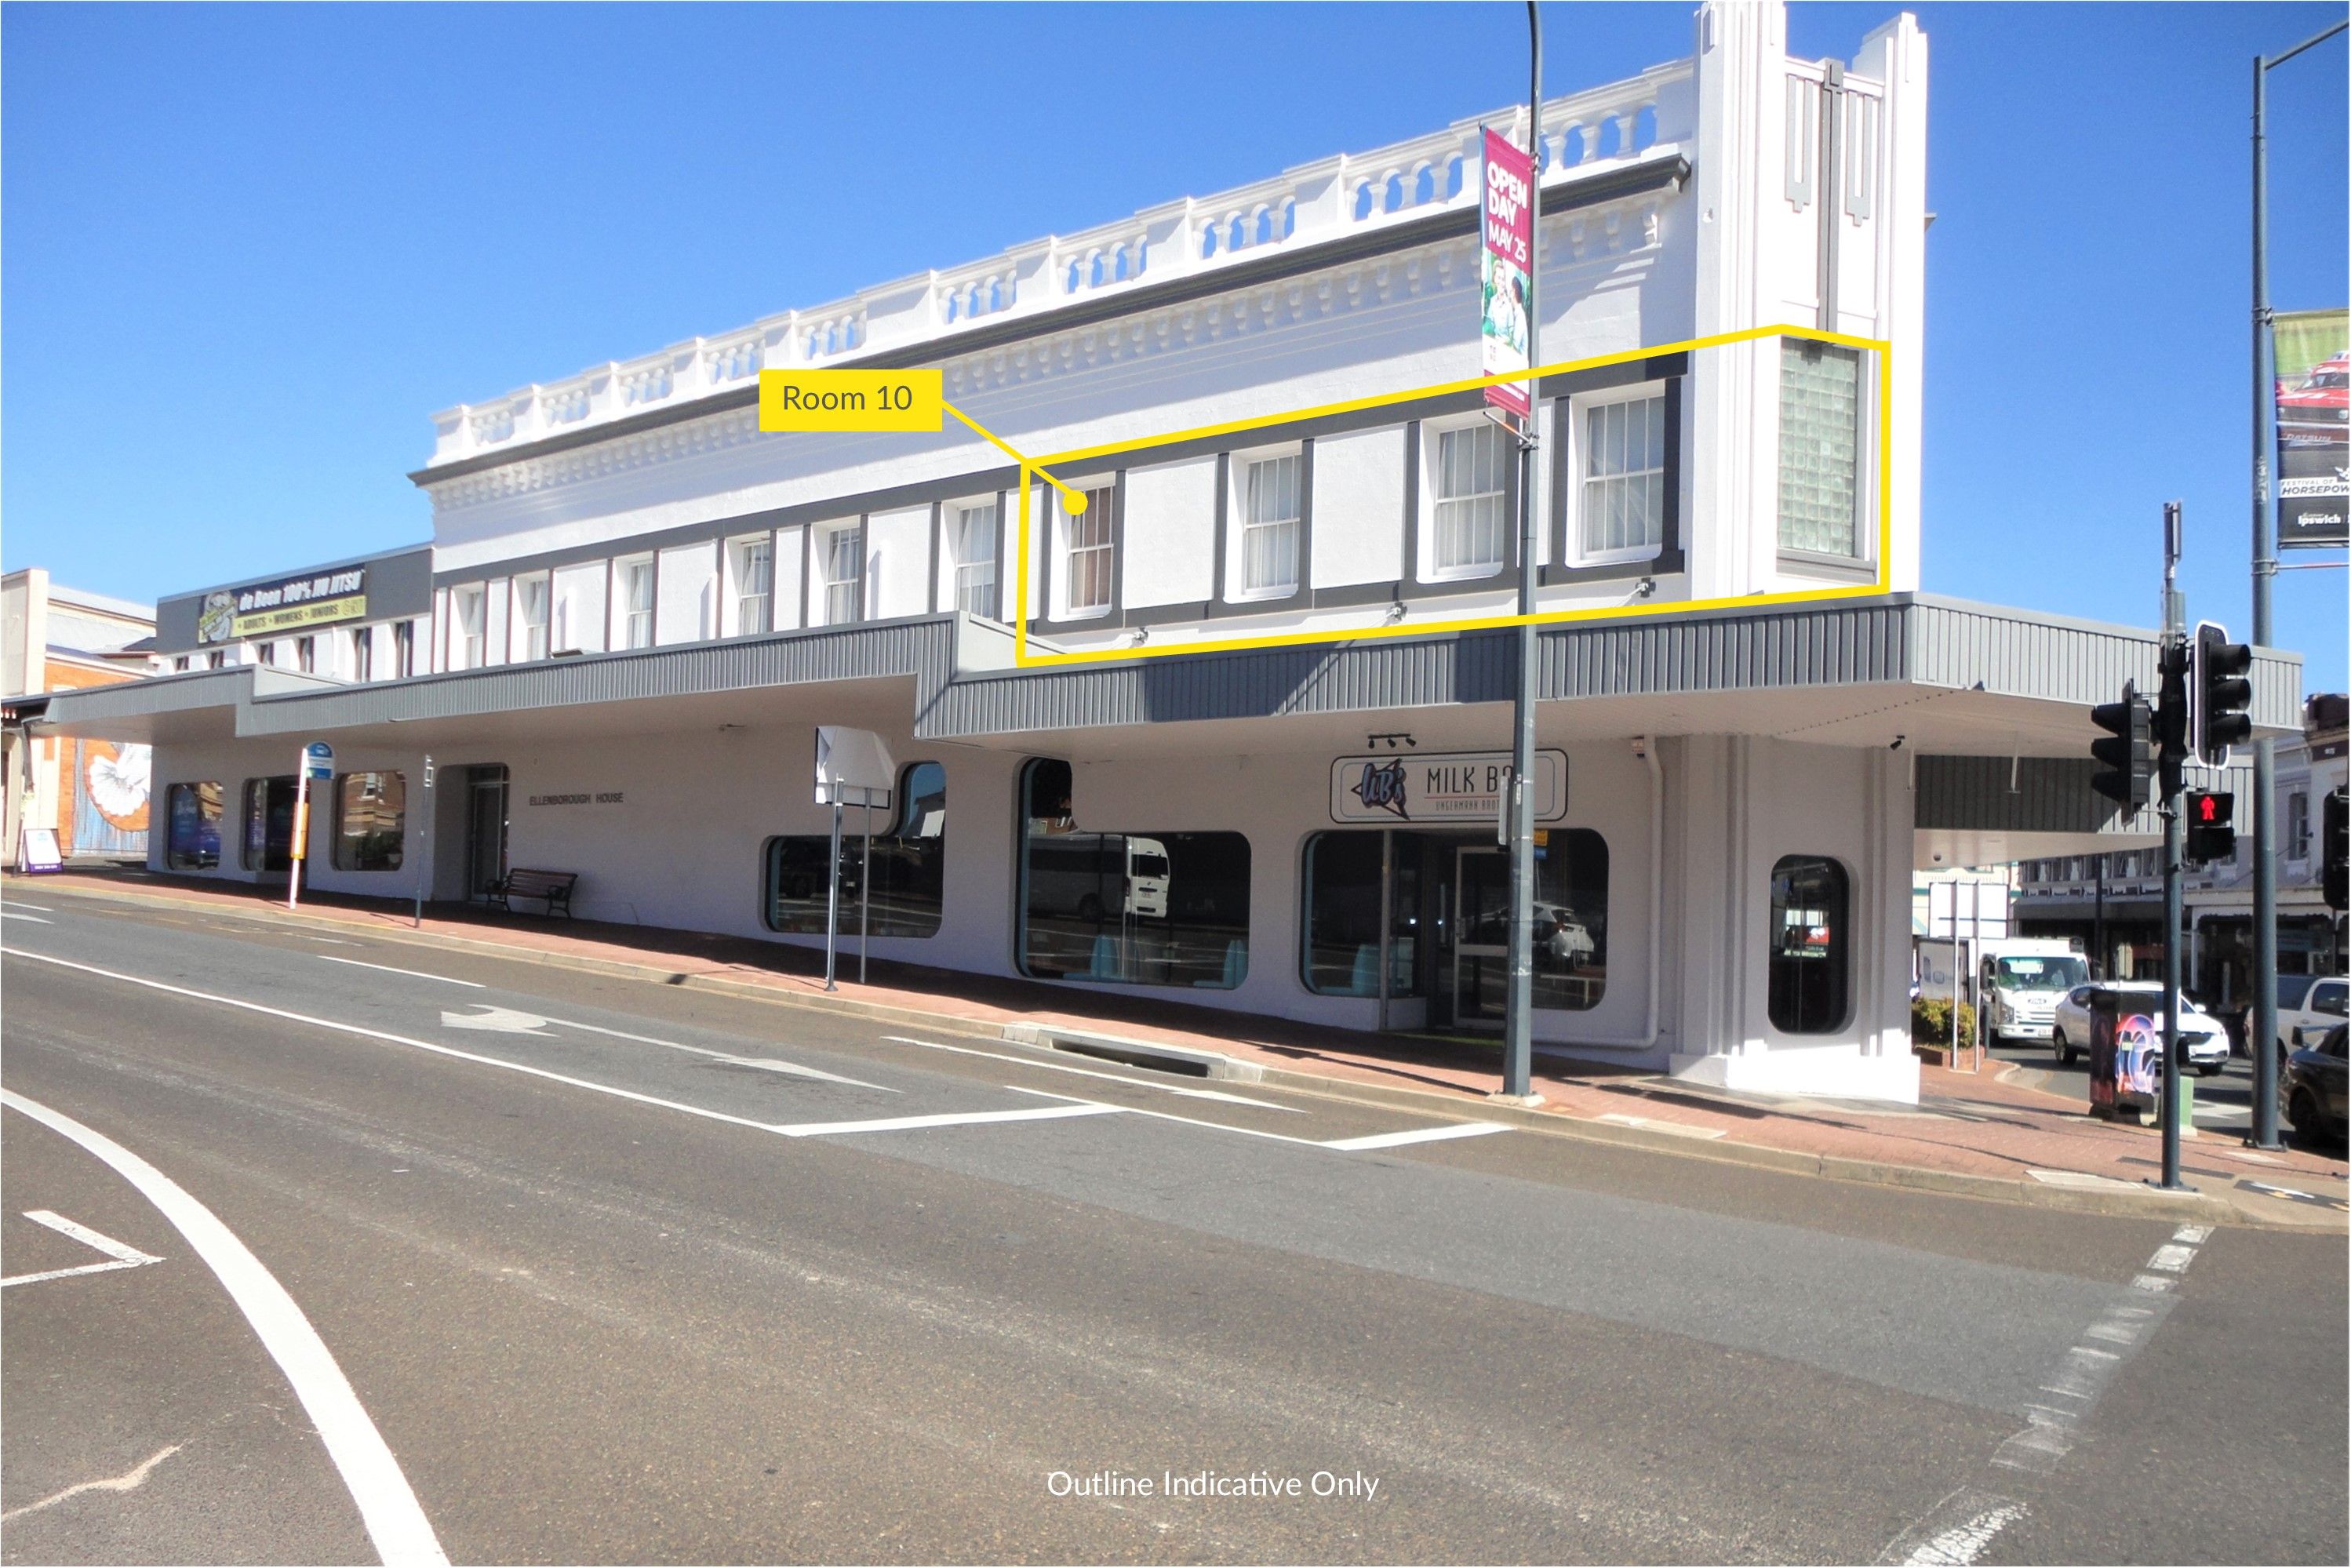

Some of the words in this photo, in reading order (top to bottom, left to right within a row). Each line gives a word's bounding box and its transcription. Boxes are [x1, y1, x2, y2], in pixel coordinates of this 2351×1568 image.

[1487, 161, 1527, 209] OPEN
[1489, 187, 1517, 227] DAY
[1489, 220, 1513, 253] MAY
[1514, 236, 1527, 264] 25
[2298, 514, 2342, 527] Ipswich
[1427, 767, 1475, 793] MILK
[530, 794, 591, 806] ELLENBOROUGH
[596, 792, 624, 803] HOUSE
